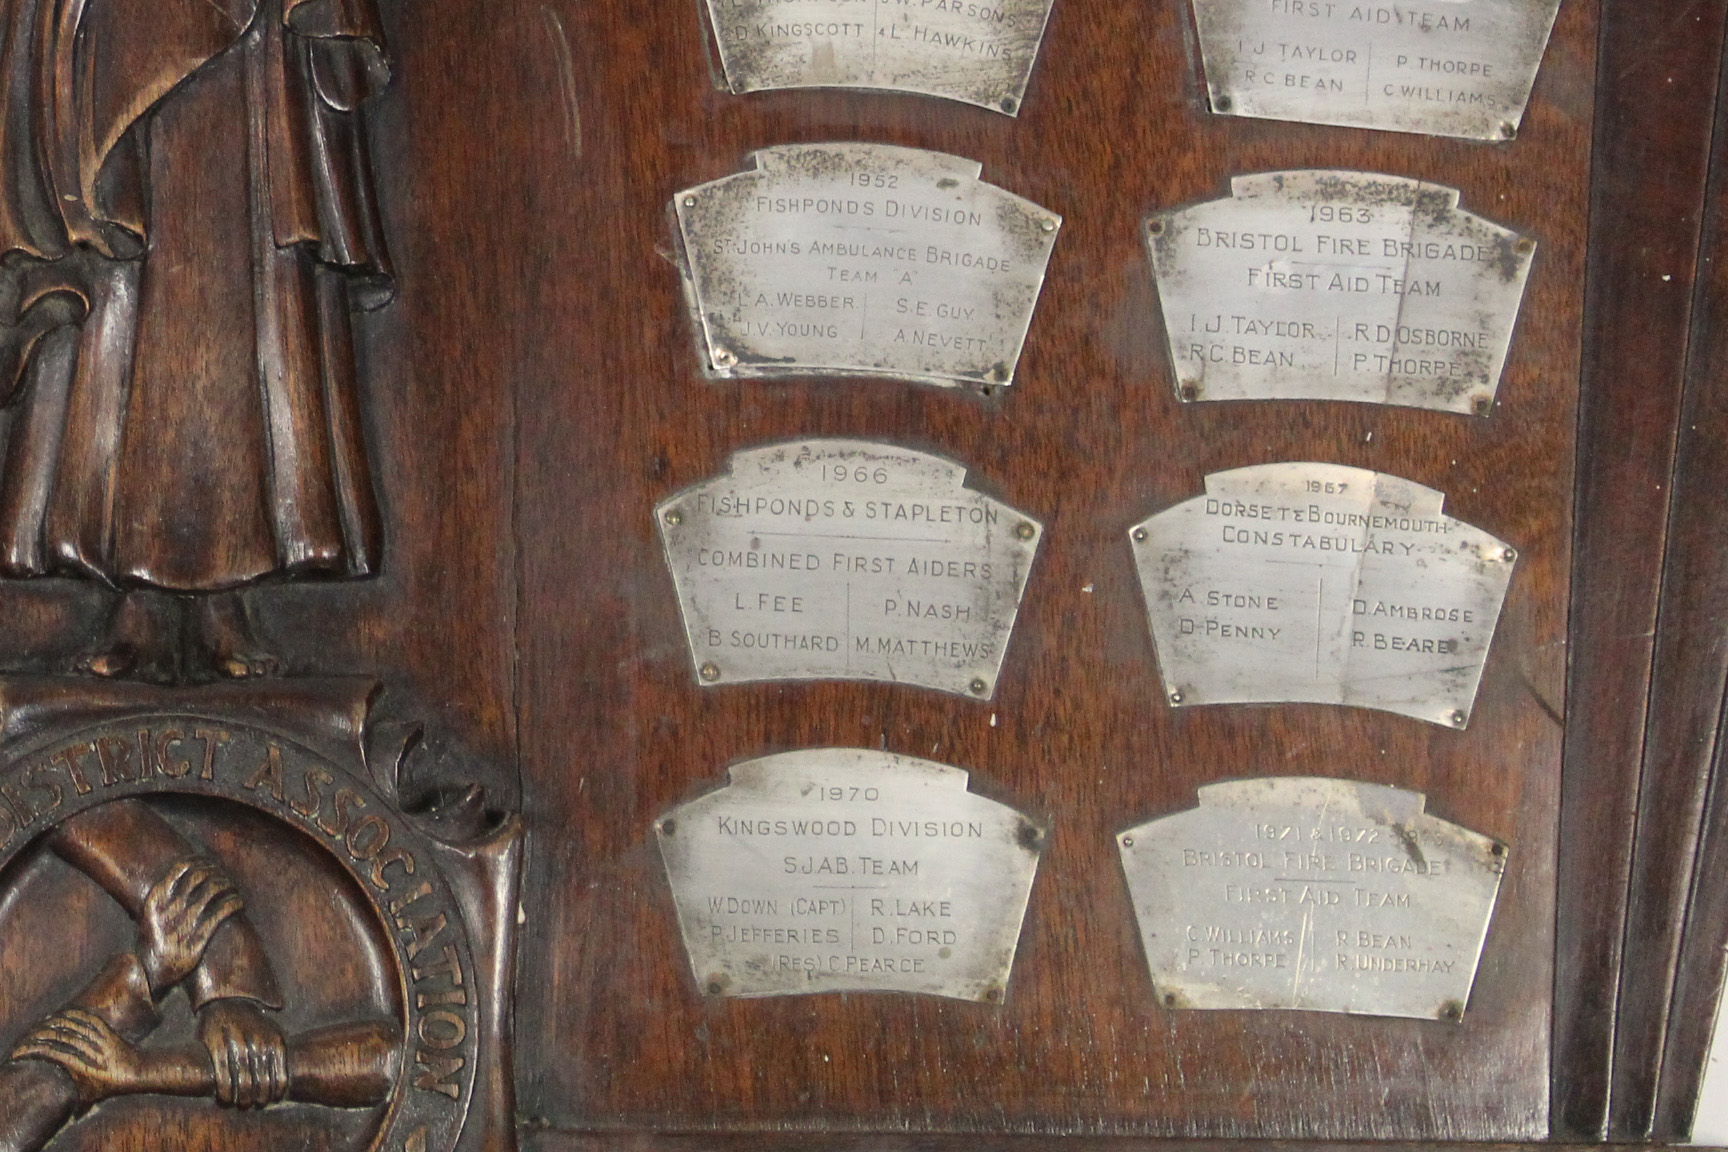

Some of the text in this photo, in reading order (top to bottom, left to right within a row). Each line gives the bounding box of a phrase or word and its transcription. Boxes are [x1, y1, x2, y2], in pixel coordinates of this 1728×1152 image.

[757, 23, 863, 38] KINGSCOTT
[1280, 43, 1357, 64] TAYLOR
[1286, 75, 1343, 92] BEAN
[850, 173, 898, 189] 1952
[757, 196, 981, 226] FISHPONDS DIVISION
[1310, 206, 1371, 224] 1963
[1197, 228, 1492, 262] BRISTOL FIRE BRIGADE
[828, 267, 877, 282] TEAM
[822, 465, 888, 484] 1966
[698, 494, 998, 525] FISHPONDS & STAPLETON
[1223, 526, 1416, 556] CONSTABULARY
[1207, 591, 1278, 610] STONE
[1206, 620, 1281, 640] PENNY
[820, 787, 879, 801] 1970
[719, 817, 983, 838] KINGSWOOD DIVISION
[1184, 849, 1442, 876] BRISTOL FIRE BRIGADE
[244, 741, 467, 1101] ASSOCIATION
